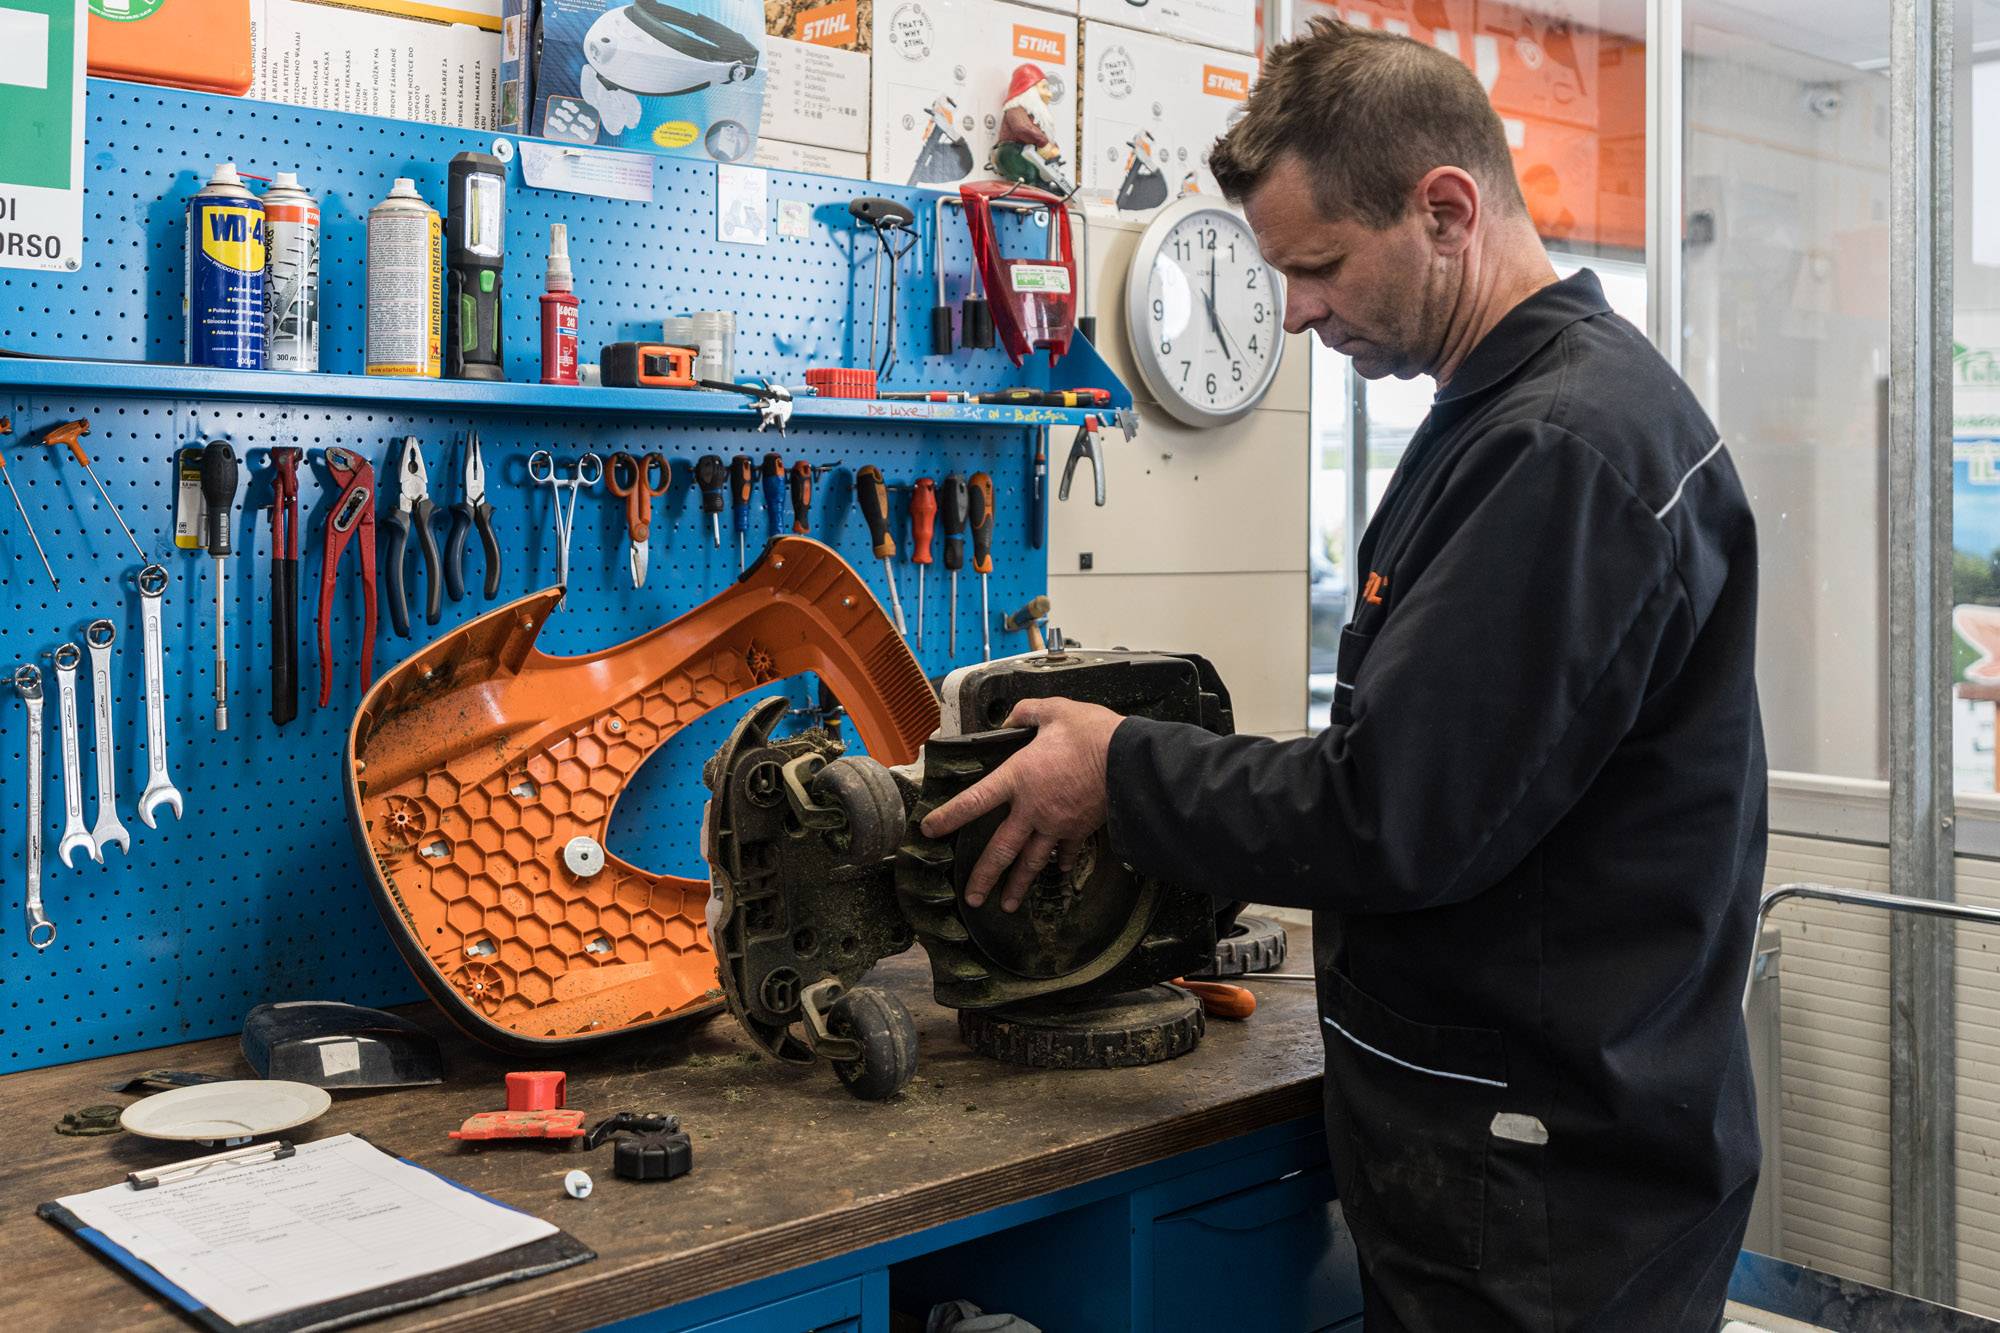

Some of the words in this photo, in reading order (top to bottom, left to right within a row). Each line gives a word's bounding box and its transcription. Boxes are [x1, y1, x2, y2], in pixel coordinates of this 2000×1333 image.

[803, 12, 851, 42] STIHL
[374, 48, 379, 58] NA
[409, 47, 414, 57] DO
[904, 39, 924, 48] STIHL
[1018, 34, 1061, 56] STIHL
[1207, 74, 1245, 94] STIHL
[210, 213, 265, 246] WD-4
[1198, 228, 1217, 250] 12
[0, 231, 61, 259] RSO
[431, 235, 441, 274] GREASE
[1174, 239, 1191, 261] 11
[1228, 242, 1235, 262] 1
[1246, 268, 1257, 289] 2
[431, 276, 441, 336] MICROFLON
[1153, 299, 1164, 321] 9
[1254, 303, 1265, 324] 3
[1249, 334, 1258, 354] 4
[276, 353, 289, 361] 300
[1181, 361, 1192, 382] 7
[1232, 361, 1243, 382] 5
[1206, 373, 1217, 395] 6
